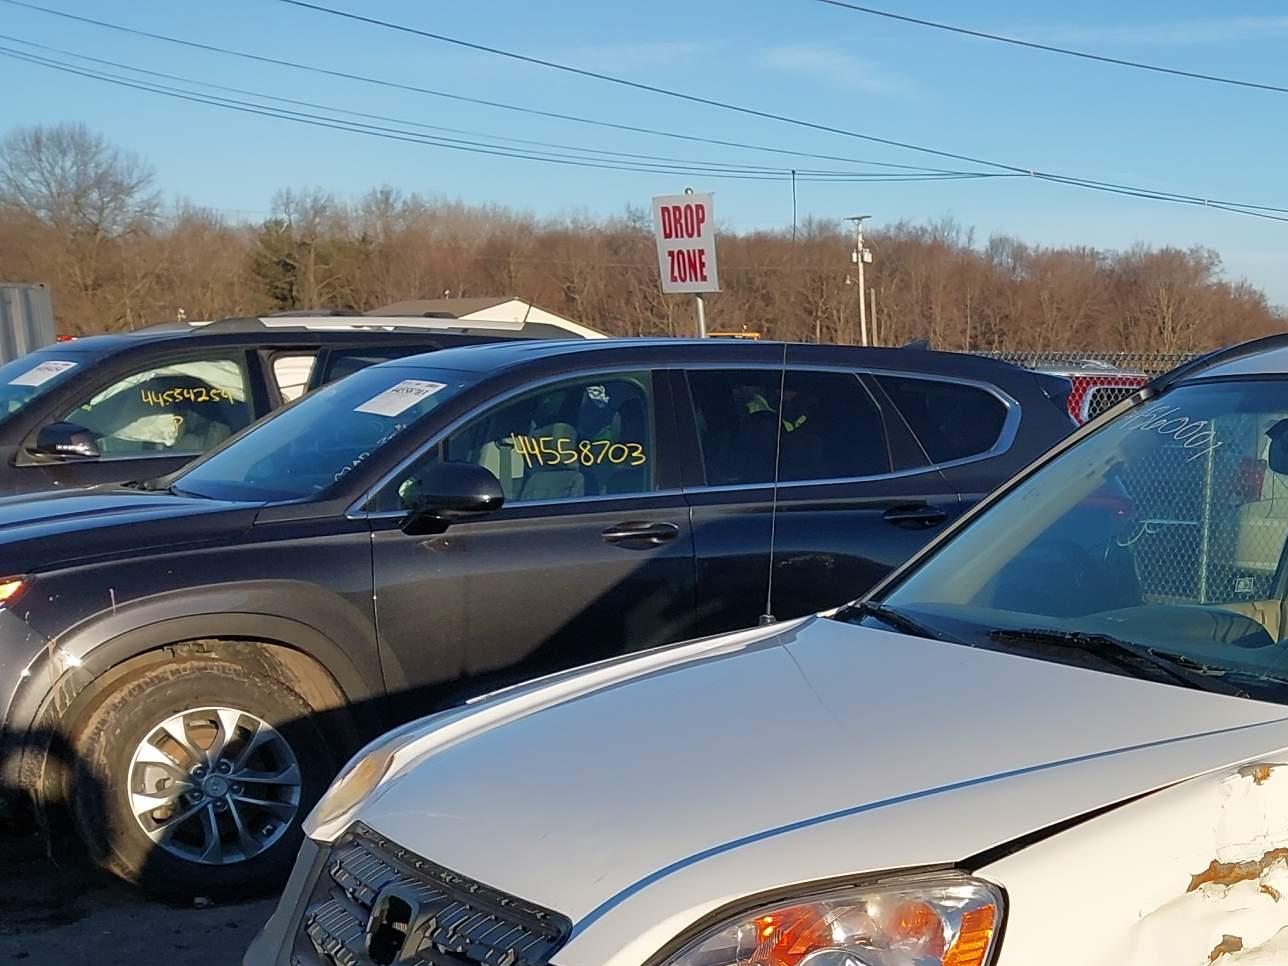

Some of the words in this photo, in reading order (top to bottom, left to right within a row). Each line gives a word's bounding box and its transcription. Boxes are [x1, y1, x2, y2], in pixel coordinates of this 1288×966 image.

[660, 203, 706, 239] DROP
[667, 248, 708, 283] ZONE
[510, 432, 647, 468] 44558703
